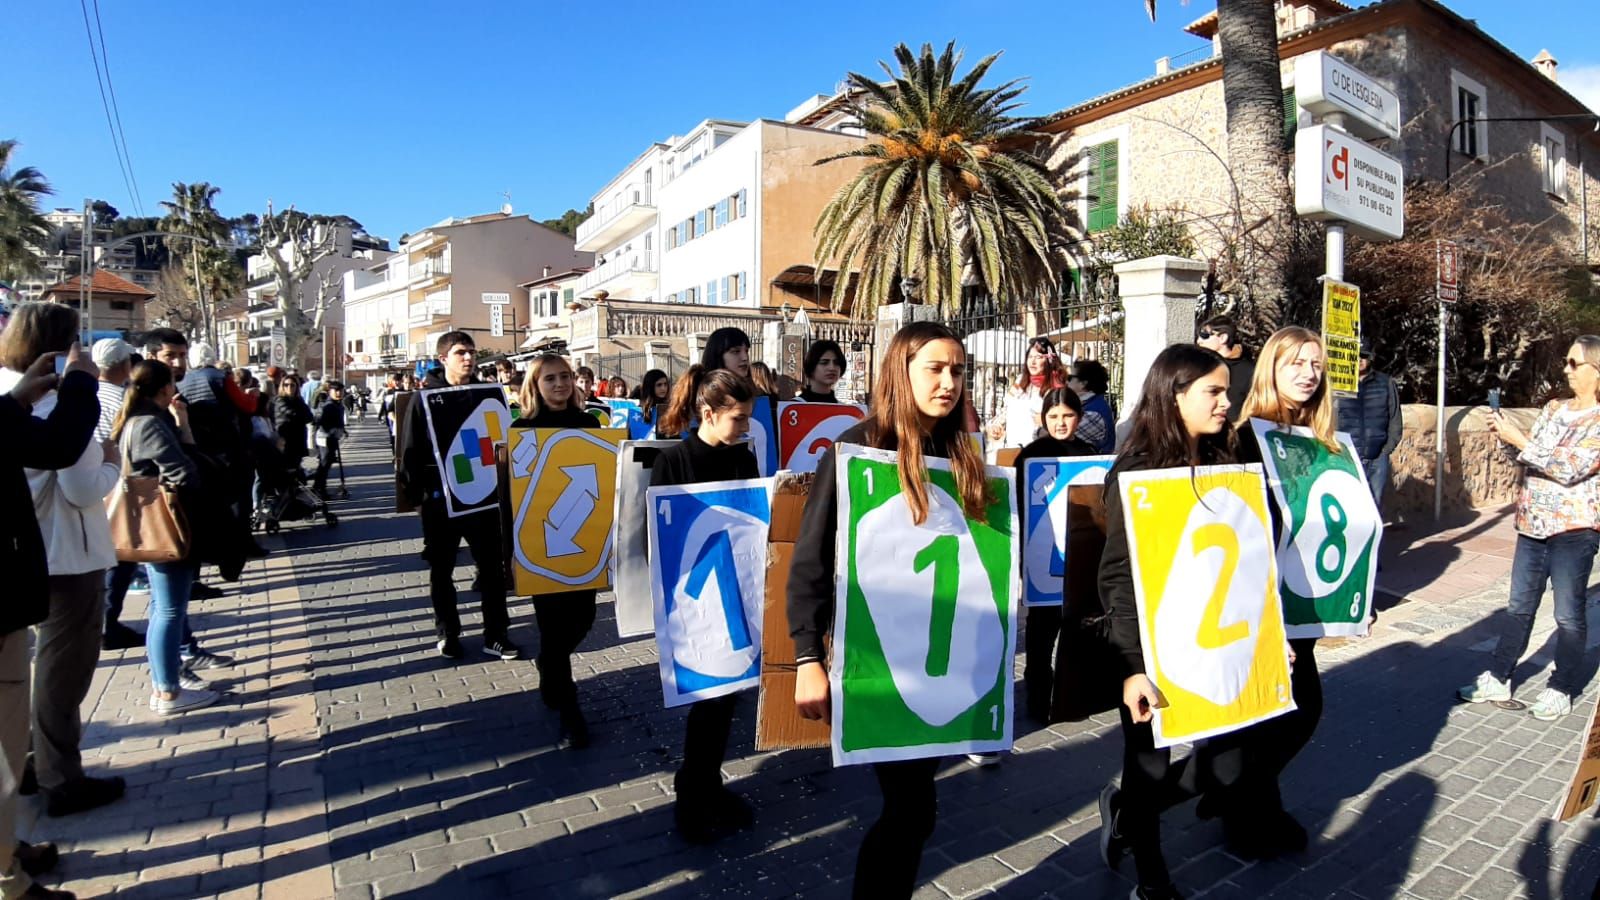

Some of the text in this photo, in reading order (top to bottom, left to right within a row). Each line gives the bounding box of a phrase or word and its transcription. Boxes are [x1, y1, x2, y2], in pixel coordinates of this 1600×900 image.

[1332, 69, 1384, 112] C/ DE L'ESGLESIA
[1353, 158, 1397, 185] DISPONIBLE PARA
[1356, 176, 1364, 188] SU
[1365, 180, 1395, 200] PUBLICIDAD
[1359, 195, 1369, 208] 971
[1386, 205, 1393, 216] 22
[428, 394, 444, 405] +4
[788, 410, 799, 426] 3
[1274, 437, 1287, 459] 8
[863, 467, 875, 495] 1
[1133, 487, 1153, 509] 2
[658, 499, 673, 526] 1
[1316, 492, 1348, 584] 8
[684, 529, 752, 652] 1
[1192, 522, 1250, 650] 2
[913, 534, 960, 678] 1
[1350, 592, 1361, 618] 8
[989, 704, 999, 732] 1
